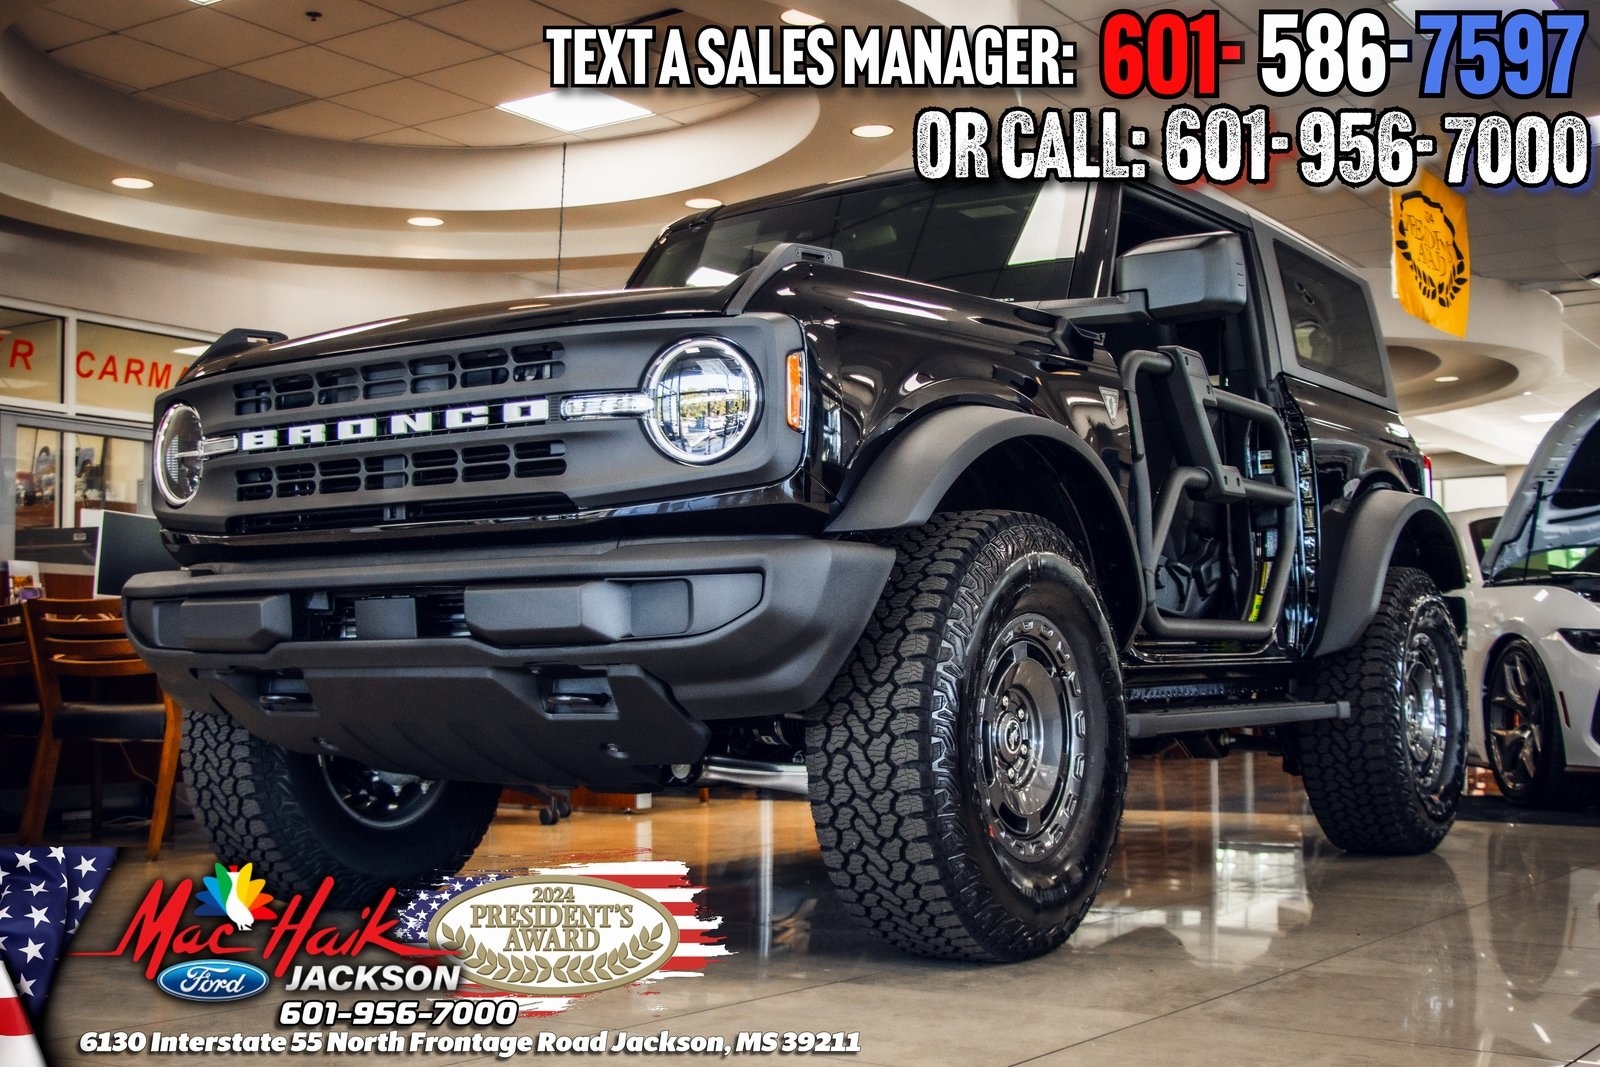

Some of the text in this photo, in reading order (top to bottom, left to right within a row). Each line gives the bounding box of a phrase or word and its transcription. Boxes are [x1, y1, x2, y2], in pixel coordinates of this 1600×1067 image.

[0, 336, 188, 389] R CARM
[242, 399, 549, 451] BRONCO
